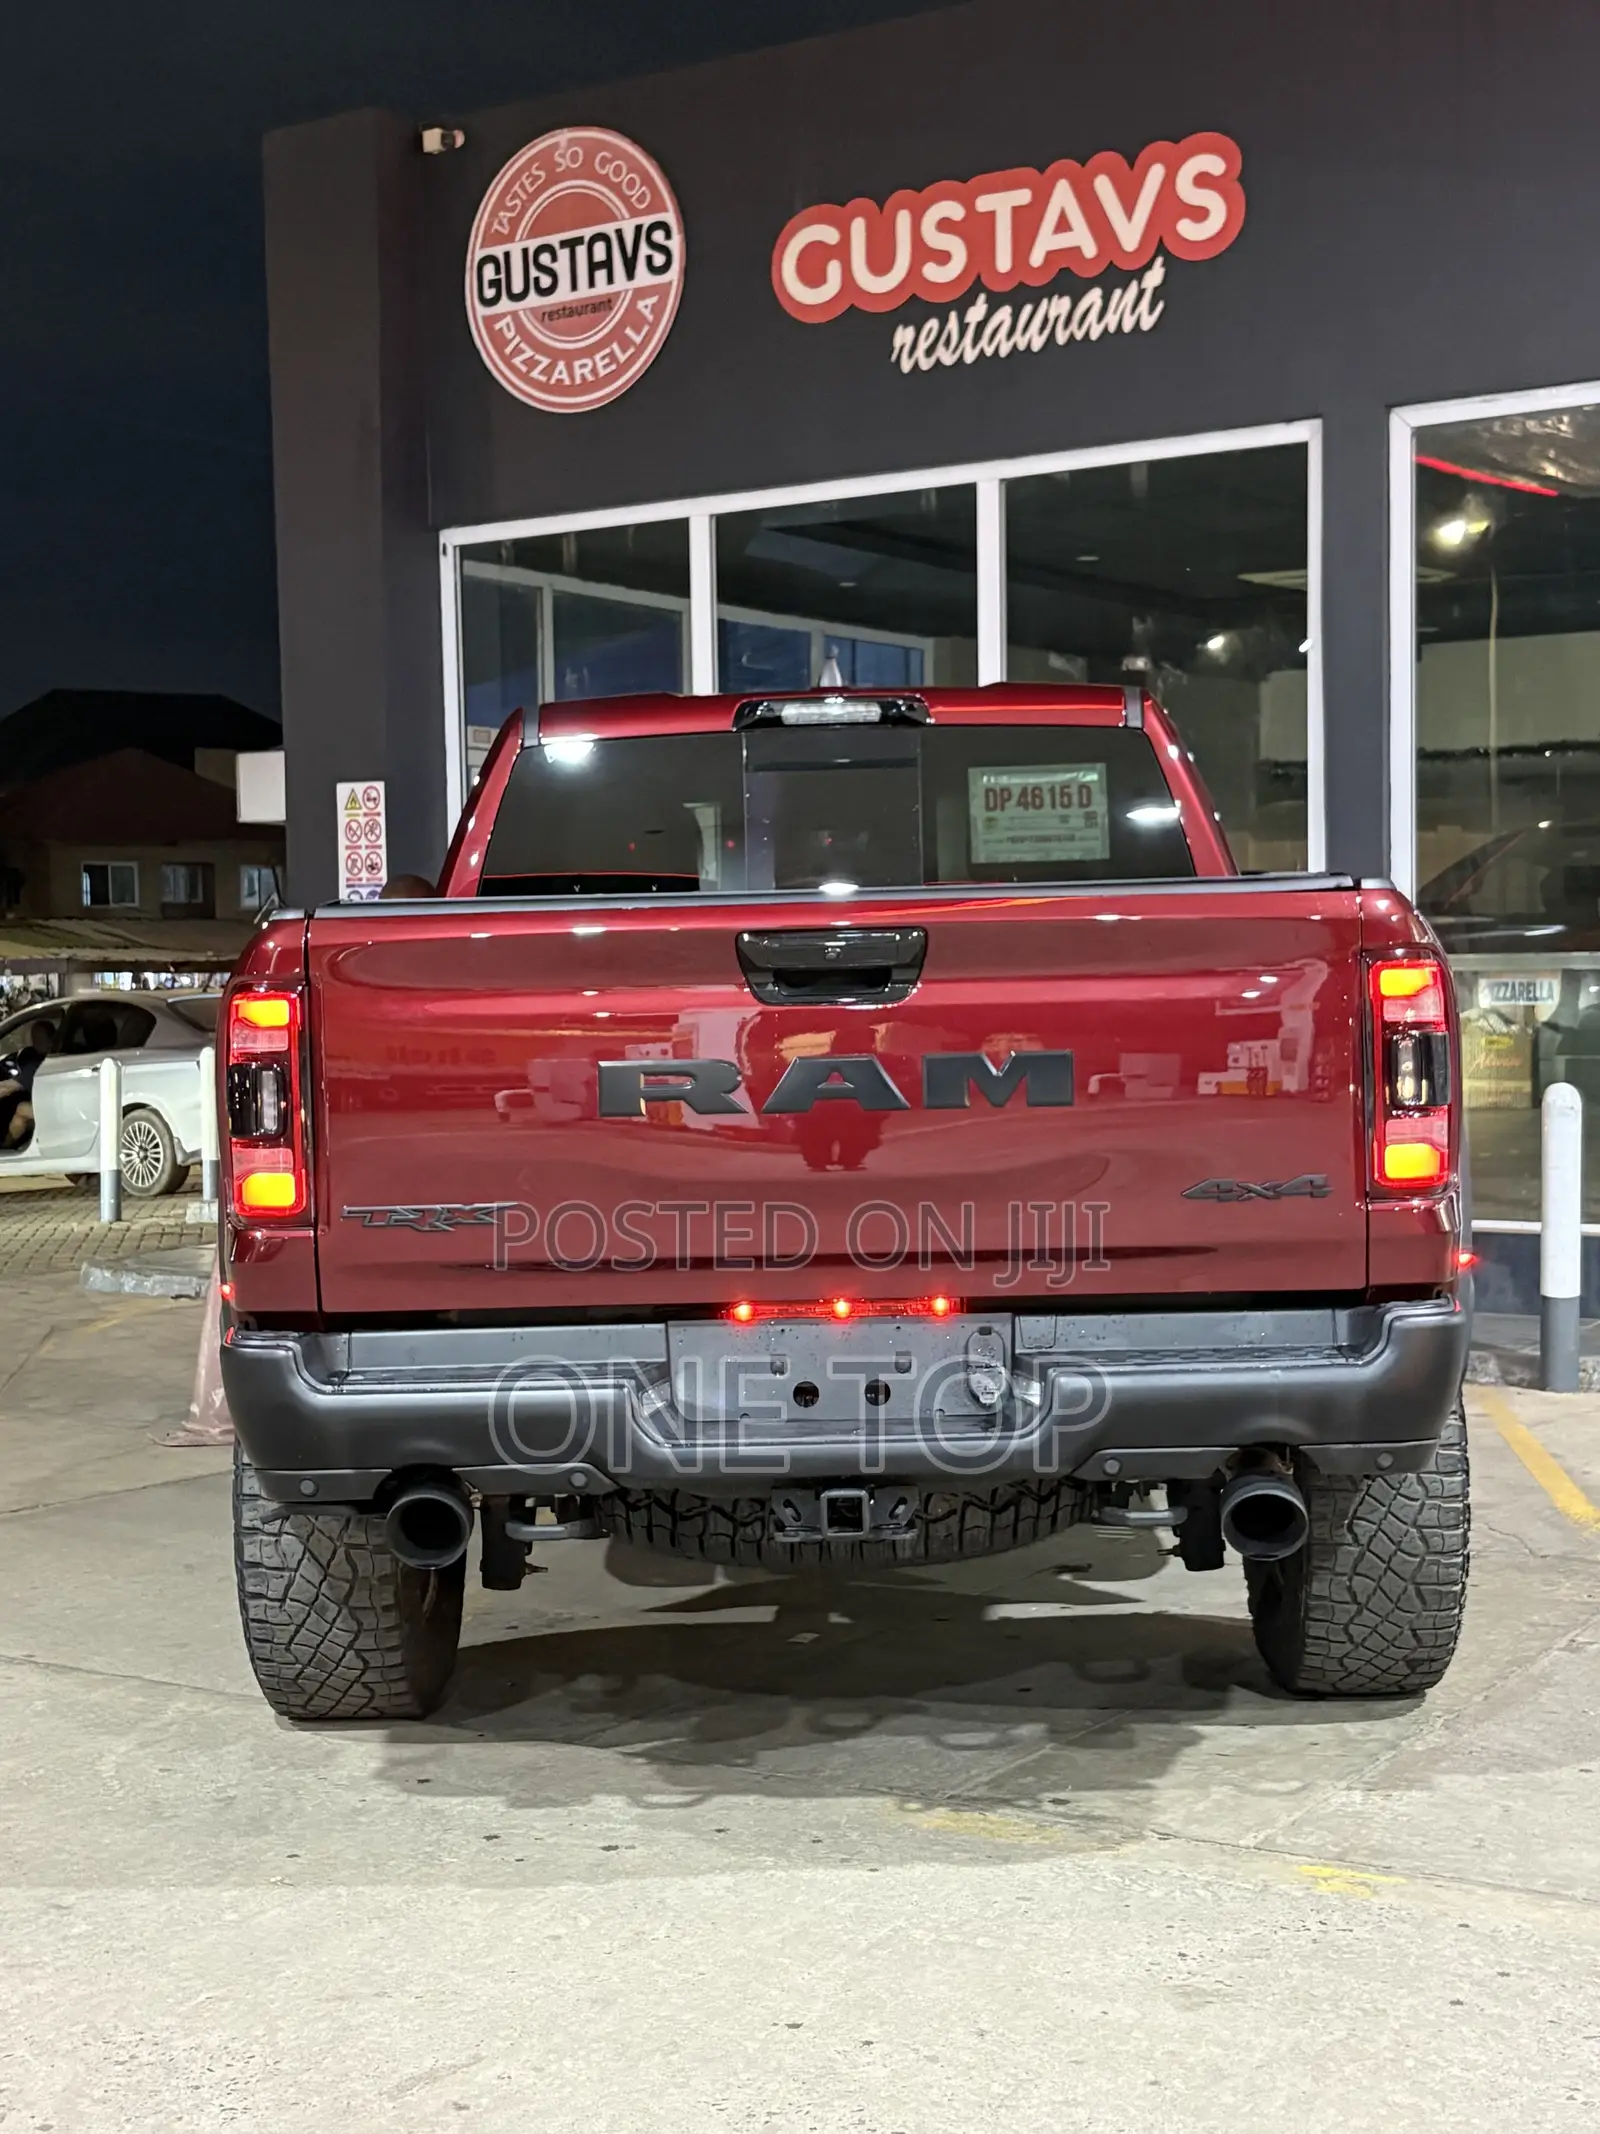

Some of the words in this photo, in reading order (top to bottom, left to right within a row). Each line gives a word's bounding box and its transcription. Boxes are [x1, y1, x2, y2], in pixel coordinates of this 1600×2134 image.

[492, 162, 546, 235] TASTES
[554, 147, 583, 172] SO
[594, 152, 651, 209] GOOD
[781, 154, 1227, 305] GUSTAVS
[476, 220, 674, 307] GUSTAVS
[494, 294, 659, 385] PIZZARELLA
[541, 298, 614, 323] restaurant
[890, 256, 1166, 373] restaurant
[984, 787, 1012, 812] DP
[1017, 784, 1073, 811] 4615
[1077, 784, 1092, 809] D
[598, 1050, 1074, 1117] RAM
[340, 1201, 519, 1232] TRX
[1181, 1173, 1335, 1202] 4x4
